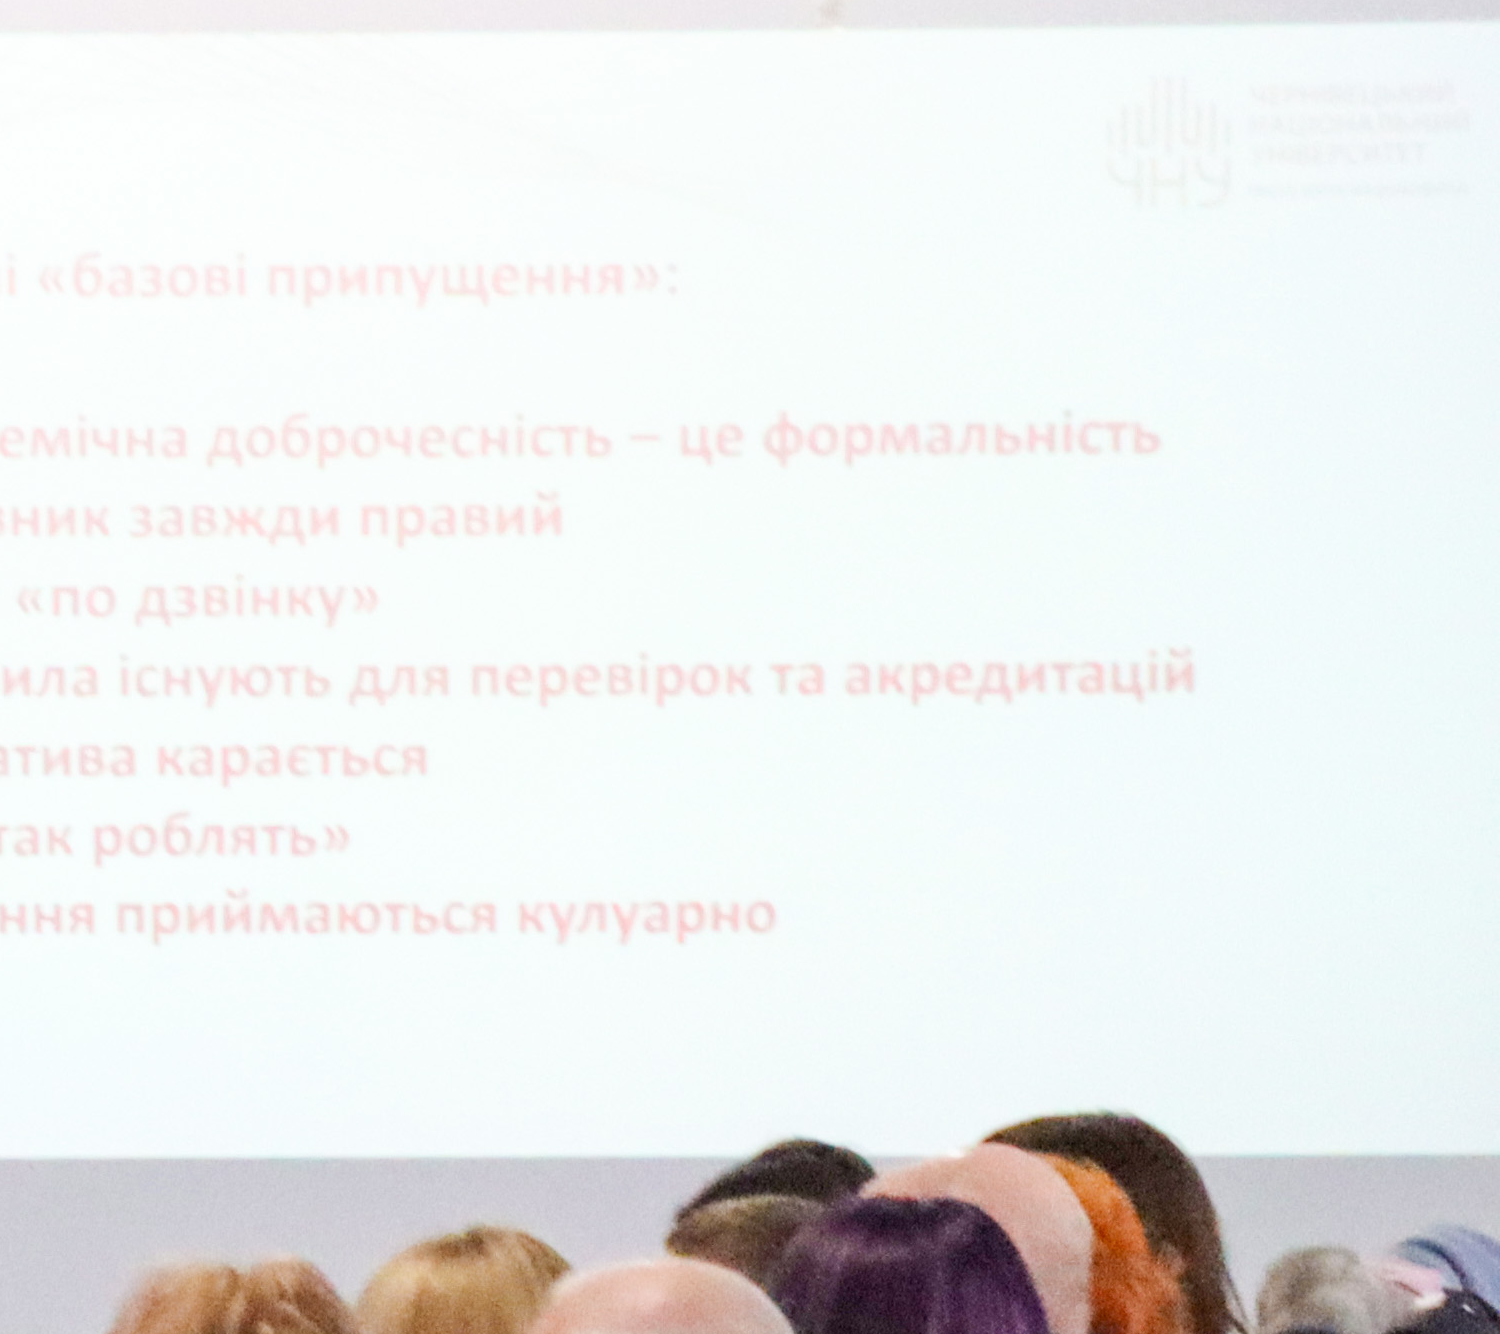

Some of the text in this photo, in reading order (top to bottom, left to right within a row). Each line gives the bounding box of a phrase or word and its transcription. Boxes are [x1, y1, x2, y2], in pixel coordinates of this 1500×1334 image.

[38, 253, 247, 298] «базові
[268, 264, 680, 307] припущення»:
[206, 412, 612, 469] доброчесність
[680, 424, 743, 464] це
[763, 410, 1160, 466] формальність
[130, 506, 339, 544] завжди
[361, 491, 562, 547] правий
[17, 586, 116, 618] «по
[135, 574, 377, 627] дзвінку»
[120, 655, 331, 706] існують
[349, 665, 449, 704] для
[472, 652, 751, 706] перевірок
[771, 663, 824, 696] та
[846, 649, 1194, 704] акредитацій
[158, 745, 427, 786] карається
[94, 814, 349, 866] роблять»
[118, 891, 496, 944] приймаються
[519, 901, 776, 944] кулуарно
